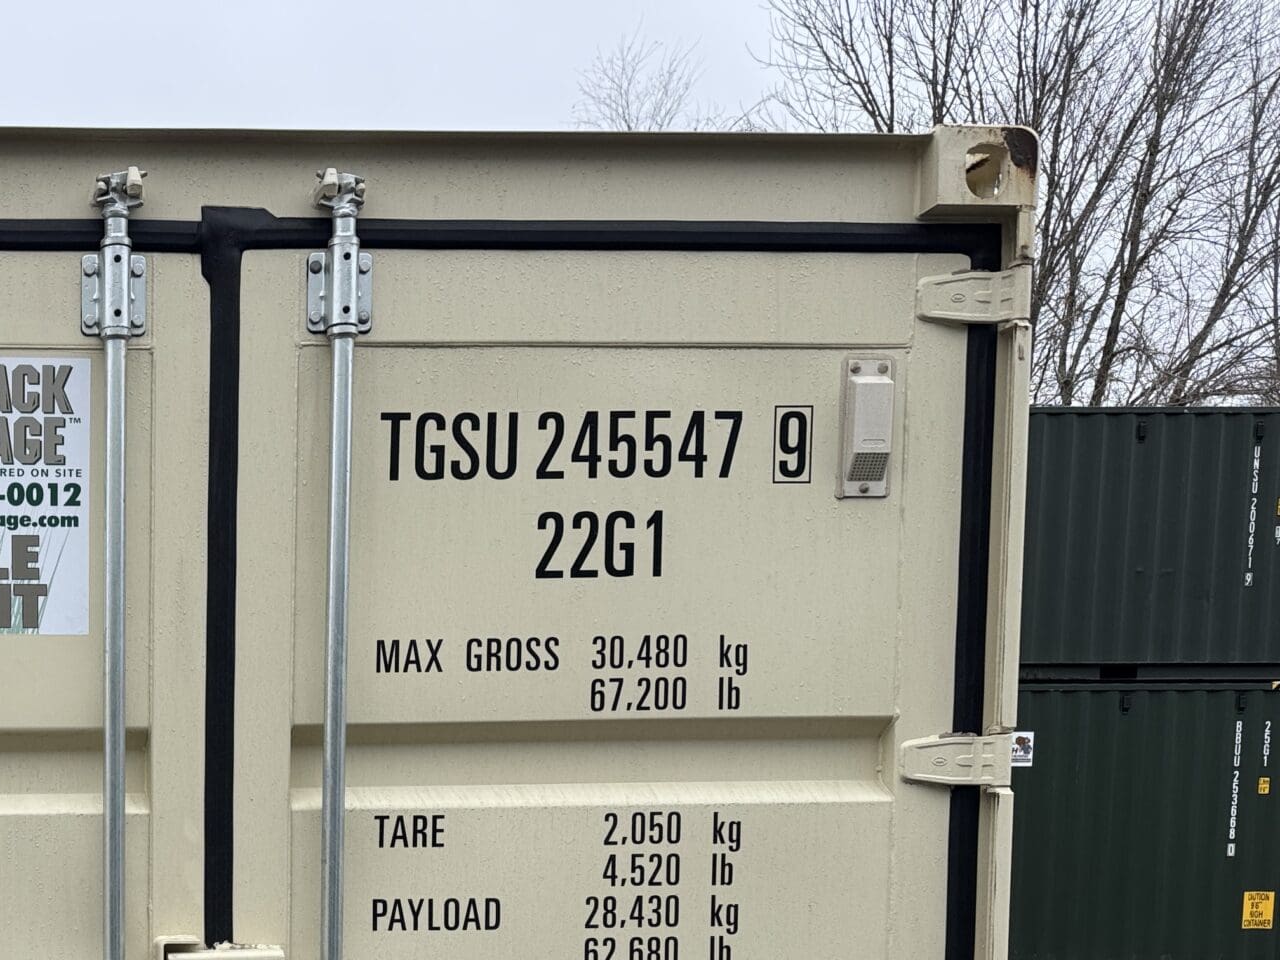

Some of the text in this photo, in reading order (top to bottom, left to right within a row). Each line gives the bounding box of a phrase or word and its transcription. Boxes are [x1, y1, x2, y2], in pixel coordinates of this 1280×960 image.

[380, 410, 808, 481] TGSU 245547 9
[31, 468, 49, 477] ON
[55, 468, 82, 478] SITE
[1245, 446, 1261, 586] UNSU 200671 9
[535, 510, 663, 578] 22G1
[375, 634, 748, 675] MAX GROSS 30,480 kg
[590, 677, 741, 712] 67,200 lb
[1233, 721, 1243, 767] BBUU
[1263, 721, 1271, 767] 25G1
[1229, 771, 1239, 839] 253668
[374, 811, 742, 852] TARE 2,050 kg
[602, 853, 734, 887] 4,520 lb
[372, 895, 739, 935] PAYLOAD 28,430 kg
